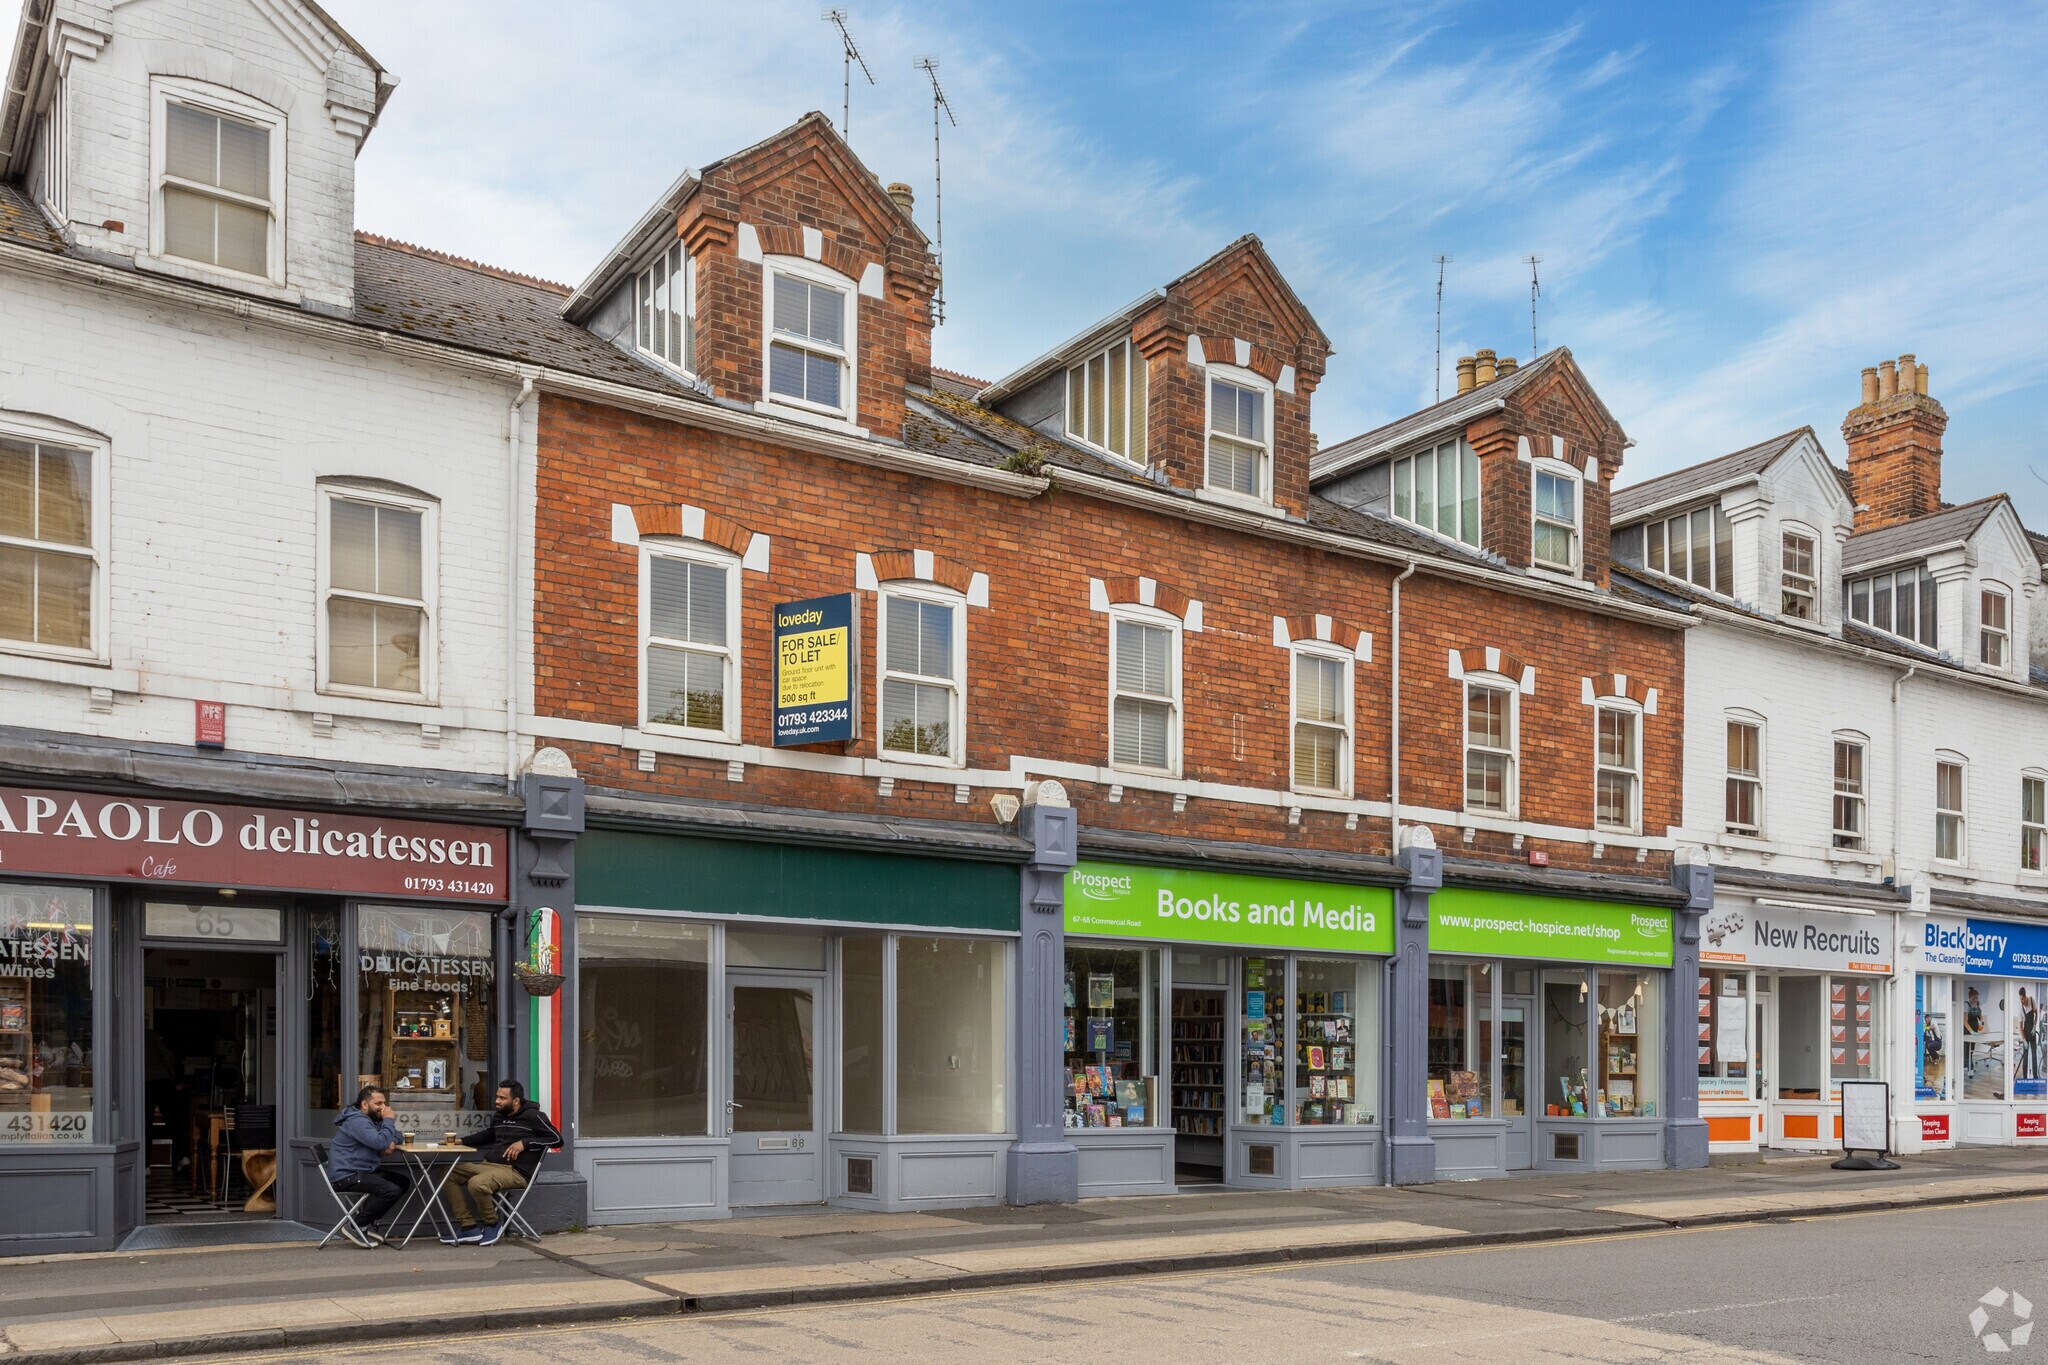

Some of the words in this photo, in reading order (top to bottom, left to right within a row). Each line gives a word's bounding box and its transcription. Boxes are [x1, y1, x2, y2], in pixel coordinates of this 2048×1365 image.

[778, 609, 823, 628] loveday
[782, 638, 804, 652] FOR
[782, 653, 797, 666] TO
[801, 650, 821, 663] LET
[782, 667, 801, 677] Ground
[801, 665, 813, 675] floor
[814, 664, 824, 673] unit
[825, 663, 836, 671] with
[782, 676, 791, 684] car
[792, 675, 807, 684] space
[792, 682, 798, 690] to
[799, 680, 824, 690] relocation
[782, 693, 796, 704] 500
[798, 692, 808, 703] sq
[810, 690, 816, 700] ft
[778, 712, 807, 727] 01793
[809, 707, 848, 724] 423344
[778, 726, 820, 736] loveday.uk.com
[239, 814, 494, 867] delicatessen
[141, 856, 177, 878] Cafe
[404, 877, 444, 892] 01793
[447, 879, 494, 895] 431420
[1072, 870, 1131, 891] Prospect
[1157, 888, 1240, 923] Books
[1247, 900, 1295, 926] and
[1303, 901, 1376, 932] Media
[196, 910, 234, 936] 65
[1072, 916, 1090, 924] 67-68
[1091, 917, 1126, 926] Commercial
[1439, 914, 1621, 941] www.prospect-hospice.net/shop
[1631, 913, 1668, 930] Prospect
[1754, 919, 1798, 949] New
[1803, 924, 1880, 956] Recruits
[1925, 923, 2008, 958] Blackberry
[1706, 952, 1732, 960] Commercial
[1925, 952, 1937, 963] The
[1939, 953, 1964, 966] Cleaning
[1966, 955, 1994, 968] Company
[2012, 953, 2031, 963] 01793
[0, 963, 55, 979] Wines
[361, 955, 495, 977] DELICATESSEN
[389, 978, 420, 992] Fine
[424, 979, 469, 993] Foods
[7, 1115, 87, 1132] 431420
[430, 1113, 493, 1129] 431420
[1923, 1119, 1941, 1127] Keeping
[2023, 1118, 2039, 1126] Keeping
[792, 1138, 805, 1148] 66
